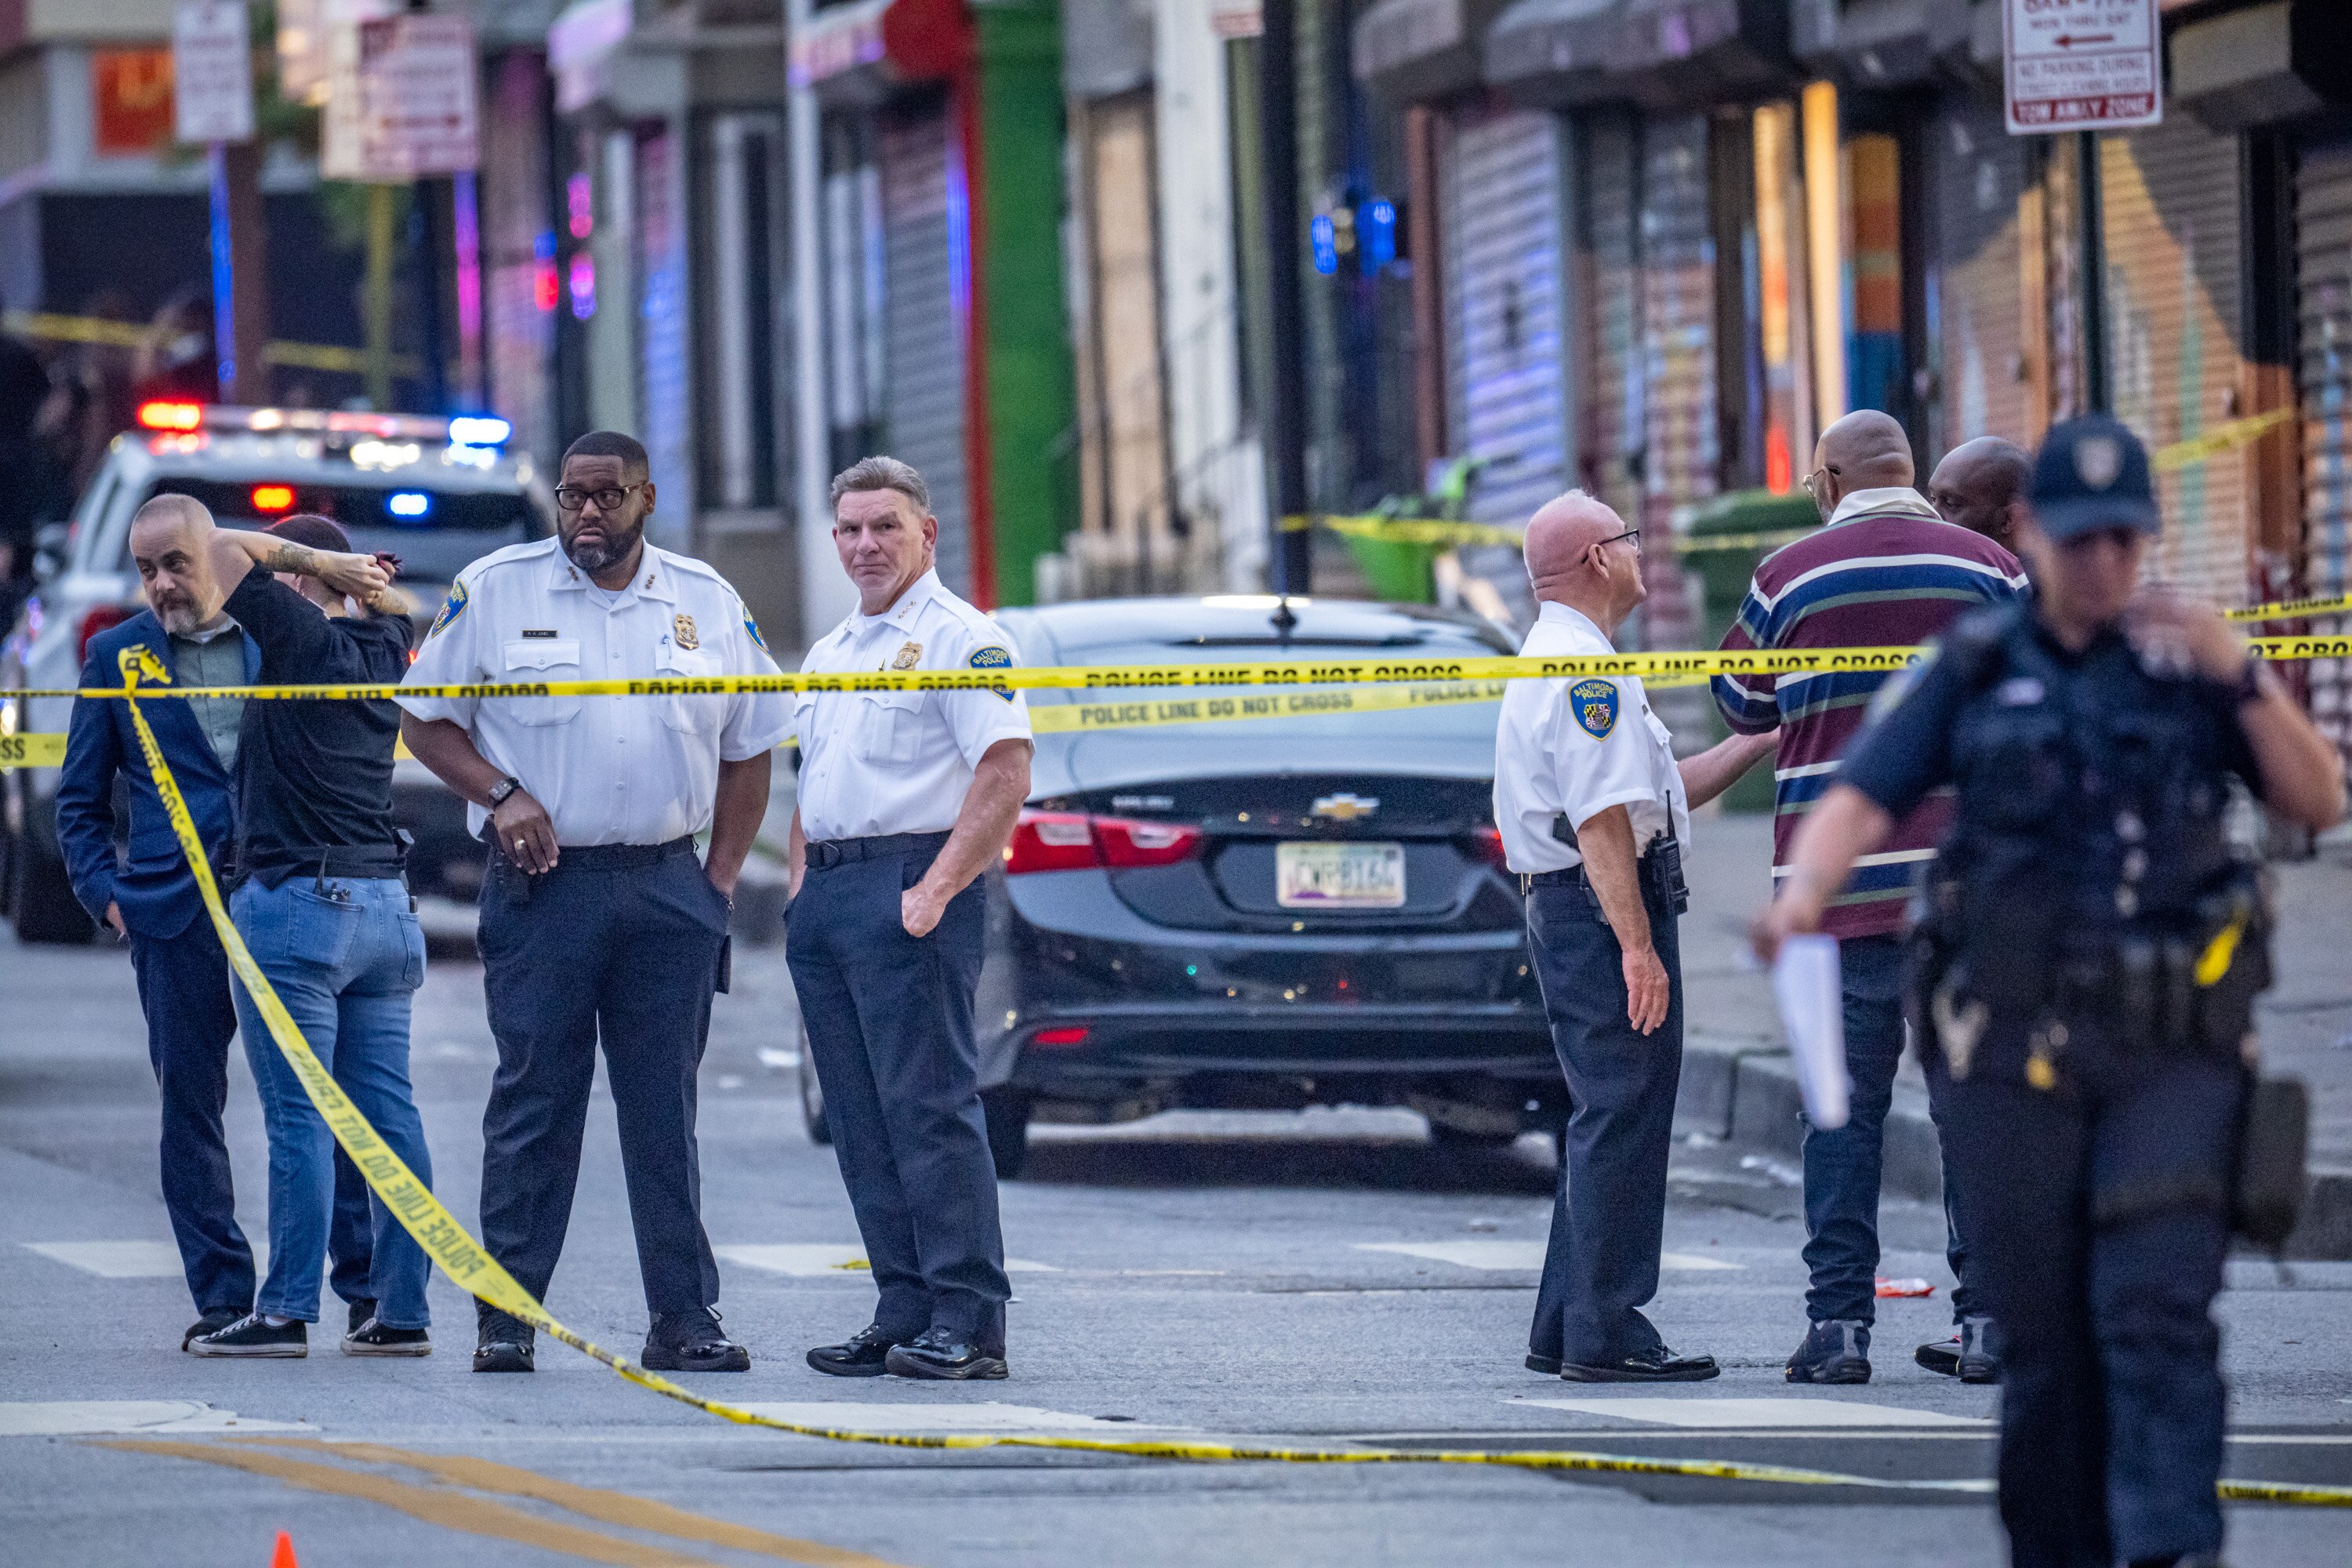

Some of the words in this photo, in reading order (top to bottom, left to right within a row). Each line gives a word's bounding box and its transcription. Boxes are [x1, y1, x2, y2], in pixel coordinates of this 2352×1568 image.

[973, 649, 1008, 665] BALTIMORE
[982, 655, 1004, 666] POLICE
[1573, 682, 1614, 696] BALTIMORE
[1582, 690, 1607, 700] POLICE
[1080, 703, 1149, 725] POLICE
[1158, 701, 1200, 721] LINE
[1208, 699, 1235, 717] DO
[1242, 697, 1279, 714] NOT
[1289, 693, 1354, 711] CROSS
